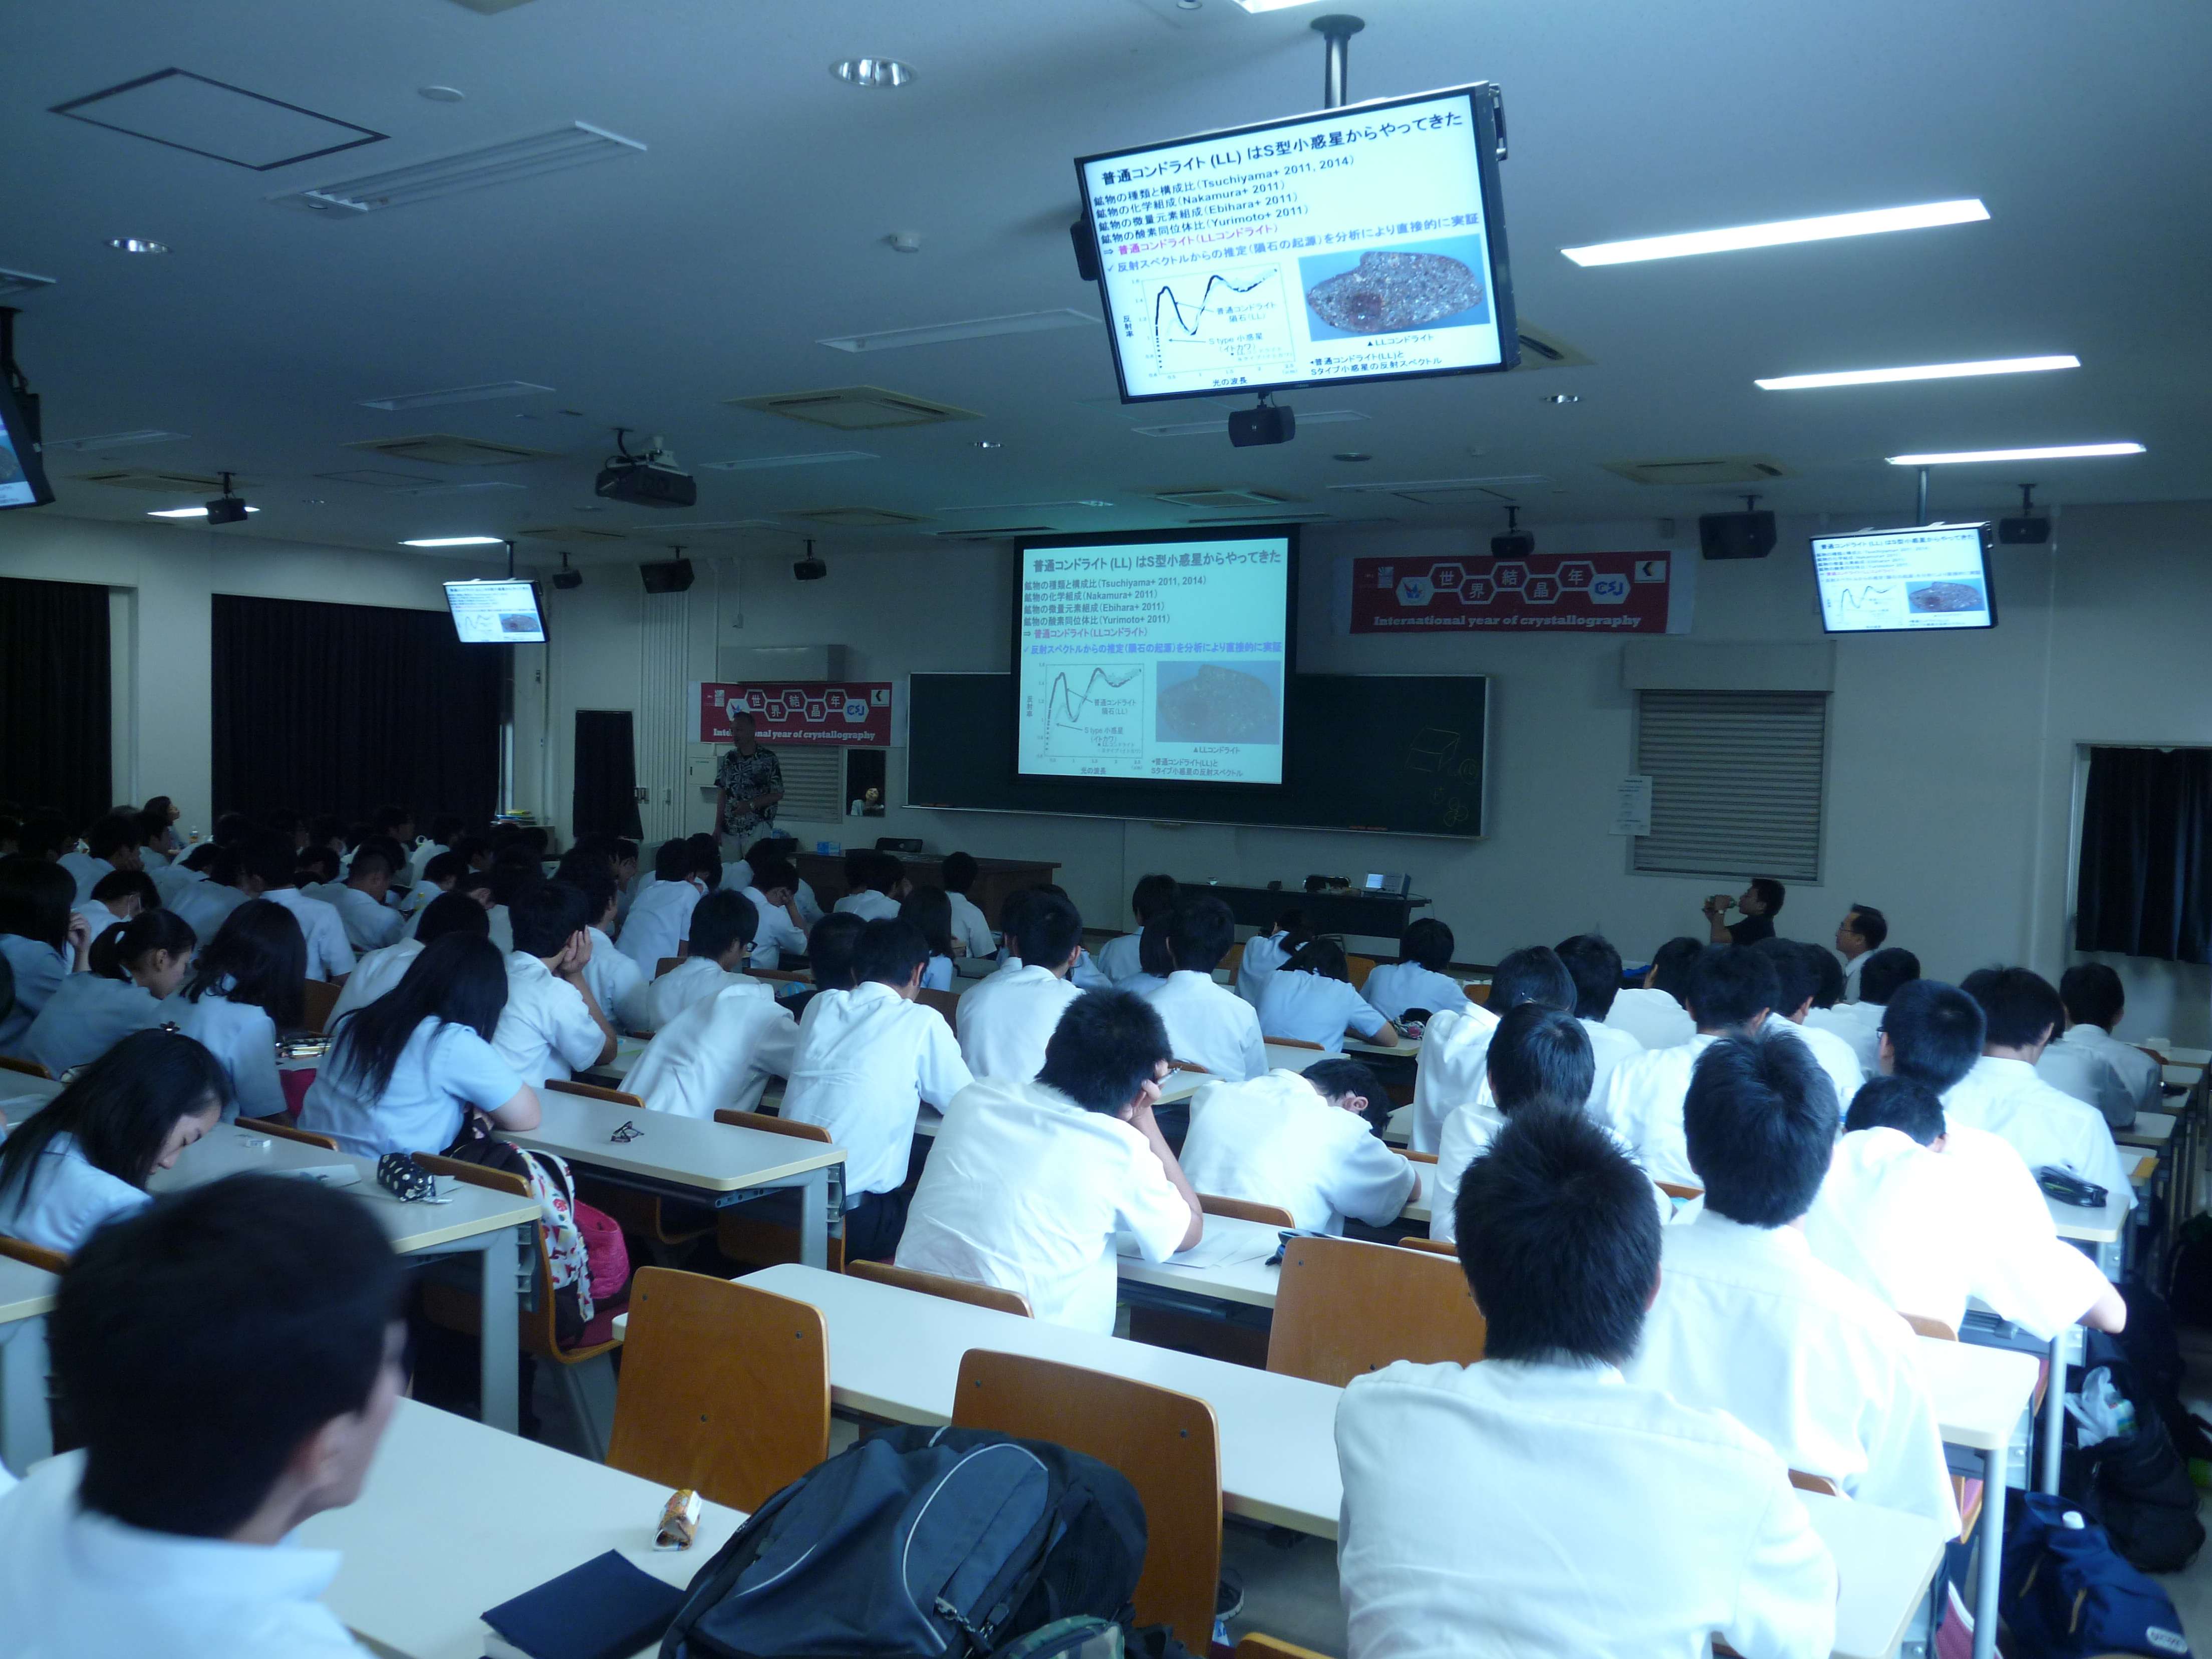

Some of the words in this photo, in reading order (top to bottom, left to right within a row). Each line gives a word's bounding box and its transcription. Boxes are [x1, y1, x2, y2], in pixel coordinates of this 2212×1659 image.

[1101, 157, 1206, 185] 普通コンドライト
[1210, 150, 1241, 168] (LL)
[1247, 111, 1463, 159] はS型小惑星からやってきた
[1217, 302, 1276, 315] 普通コンドライト
[1213, 377, 1248, 387] 光の波長
[1033, 558, 1107, 573] 普通コンドライト
[1111, 557, 1132, 571] (LL)
[1136, 549, 1281, 569] はS型小惑星からやってきた
[1374, 615, 1465, 626] International
[1468, 617, 1500, 627] year
[1502, 615, 1519, 625] of
[1520, 615, 1641, 627] crystallography
[772, 732, 791, 740] year
[803, 730, 876, 741] crystallography
